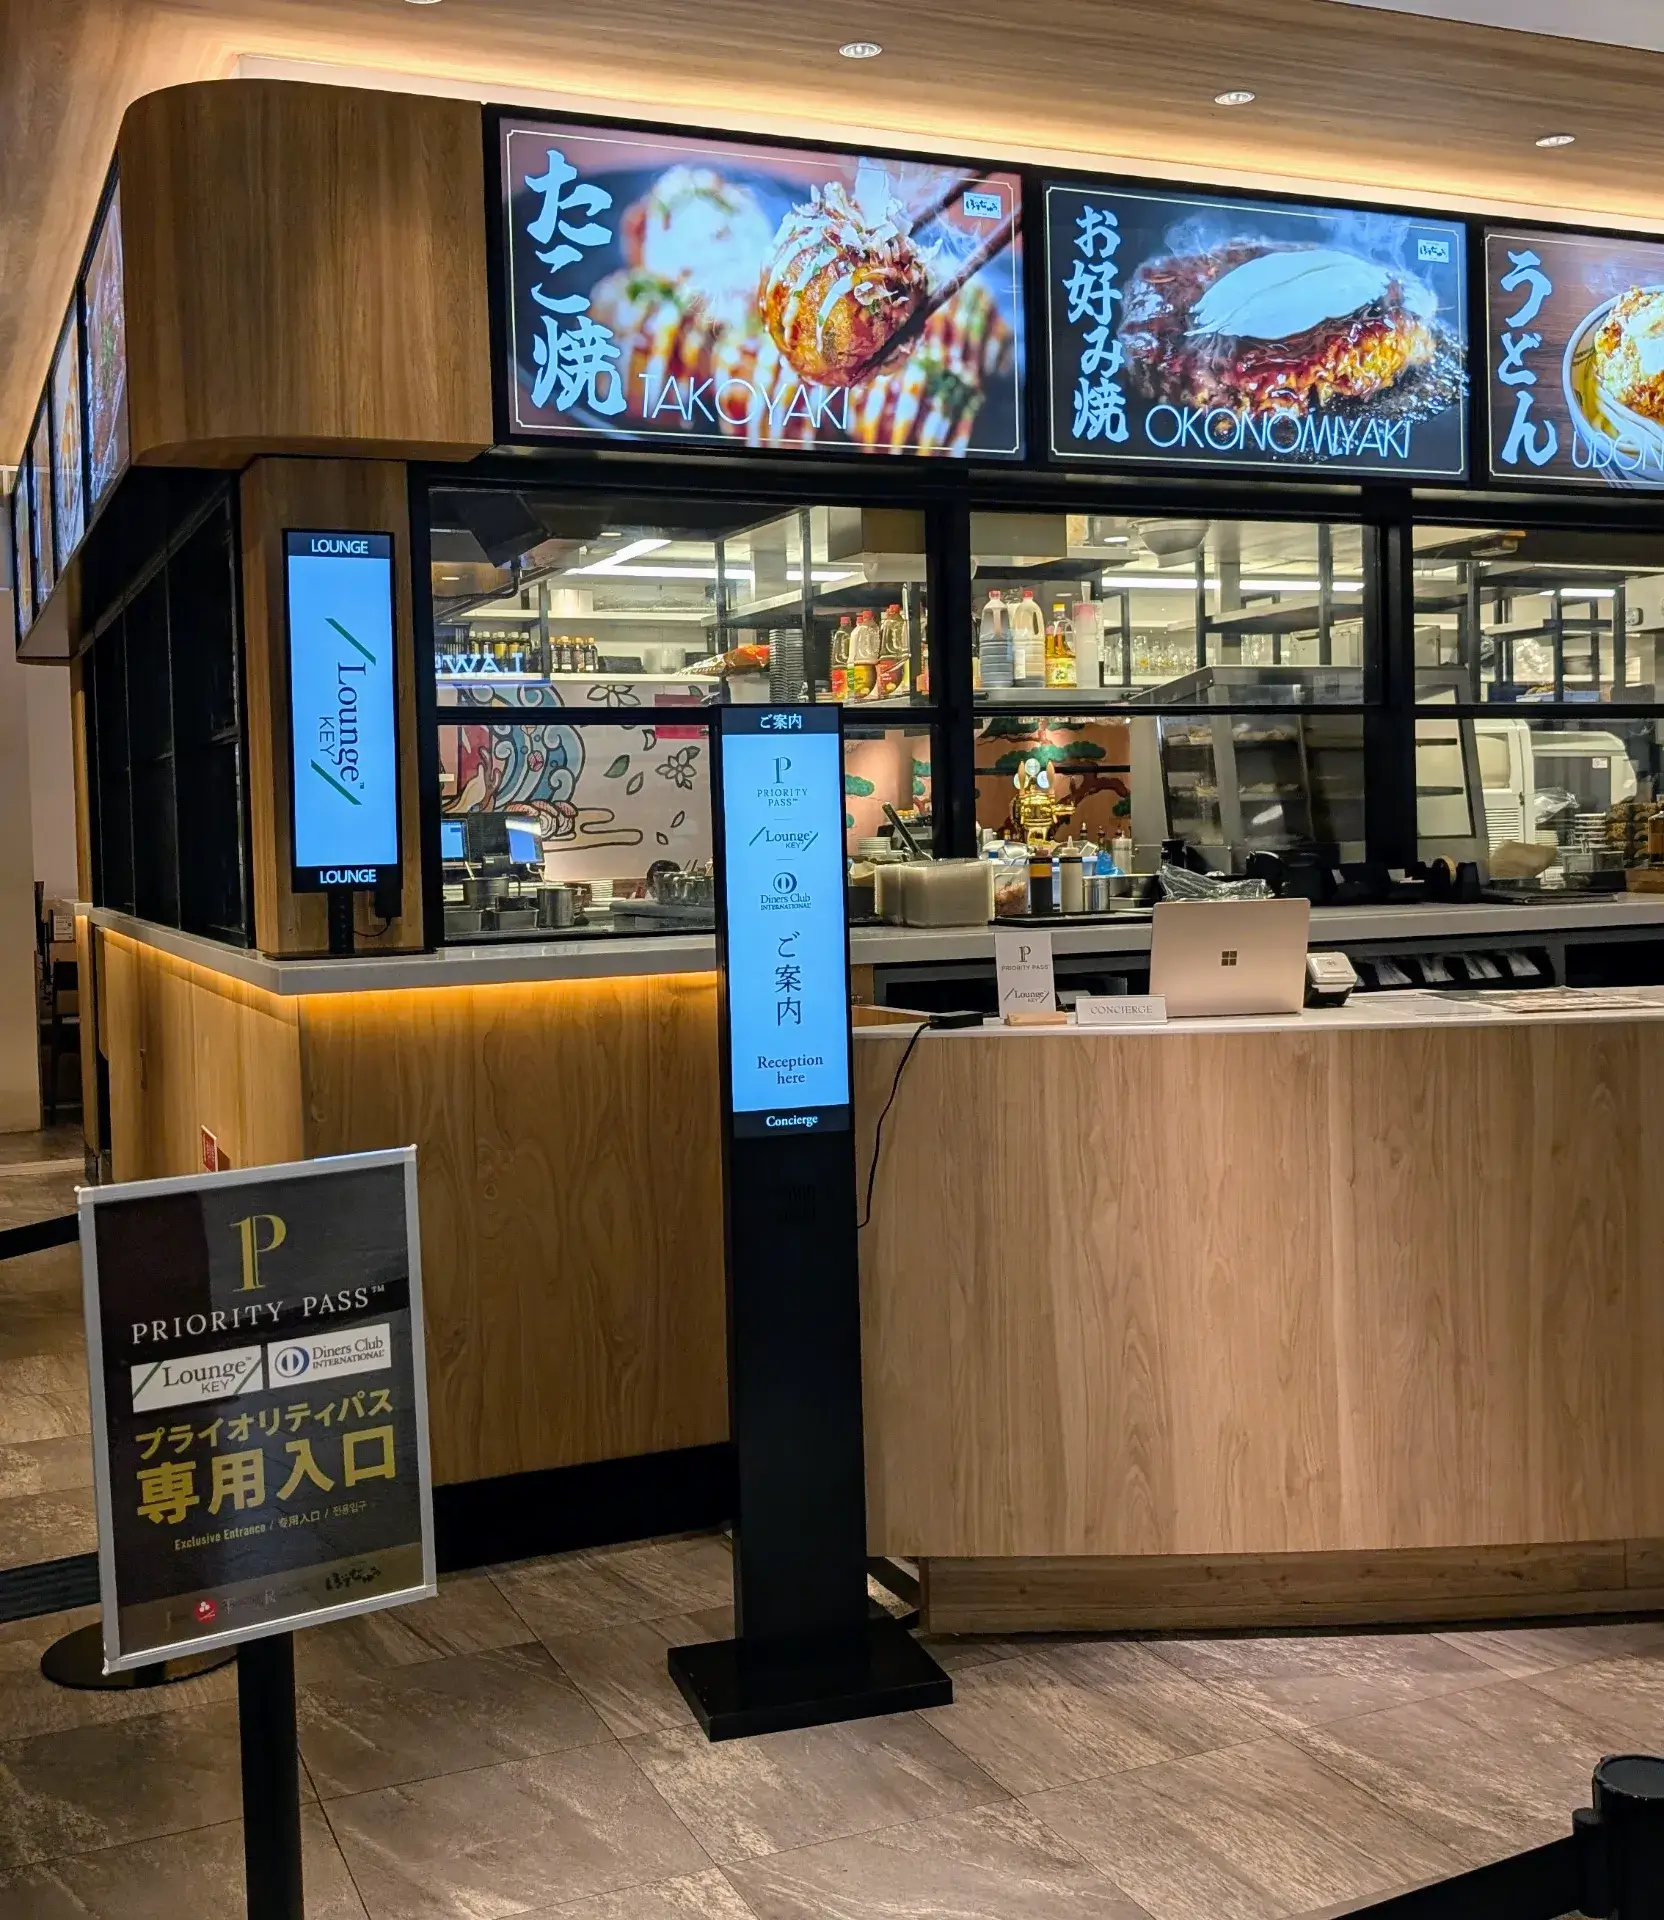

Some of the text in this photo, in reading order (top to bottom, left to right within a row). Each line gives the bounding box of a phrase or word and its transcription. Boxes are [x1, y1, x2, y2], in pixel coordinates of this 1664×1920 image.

[524, 149, 627, 416] たこ焼
[1062, 205, 1129, 443] お好み焼
[1499, 250, 1559, 467] うどん
[638, 373, 850, 431] TAKOYAKI
[1144, 405, 1412, 460] OKONOMIYAKI
[1572, 431, 1664, 471] UDON
[310, 539, 369, 555] LOUNGE
[760, 713, 803, 730] ご案内
[318, 716, 335, 757] KEY
[771, 756, 792, 784] P
[757, 788, 808, 798] PRIORITY
[319, 869, 377, 885] LOUNGE
[760, 893, 811, 904] Diners Club
[774, 931, 802, 1027] ご案内
[1090, 1004, 1153, 1015] CONCIERGE
[757, 1055, 824, 1071] Reception
[777, 1071, 806, 1084] here
[765, 1114, 819, 1128] Concierge
[229, 1214, 287, 1293] P
[131, 1300, 285, 1345] PRIORITY
[312, 1335, 384, 1361] Diners Club
[312, 1350, 384, 1369] INTERNATIONAL
[201, 1380, 230, 1394] KEY
[135, 1388, 394, 1460] プライオリティパス
[136, 1425, 397, 1525] 専用入口
[174, 1532, 221, 1551] Exclusive
[223, 1522, 266, 1541] Entrance
